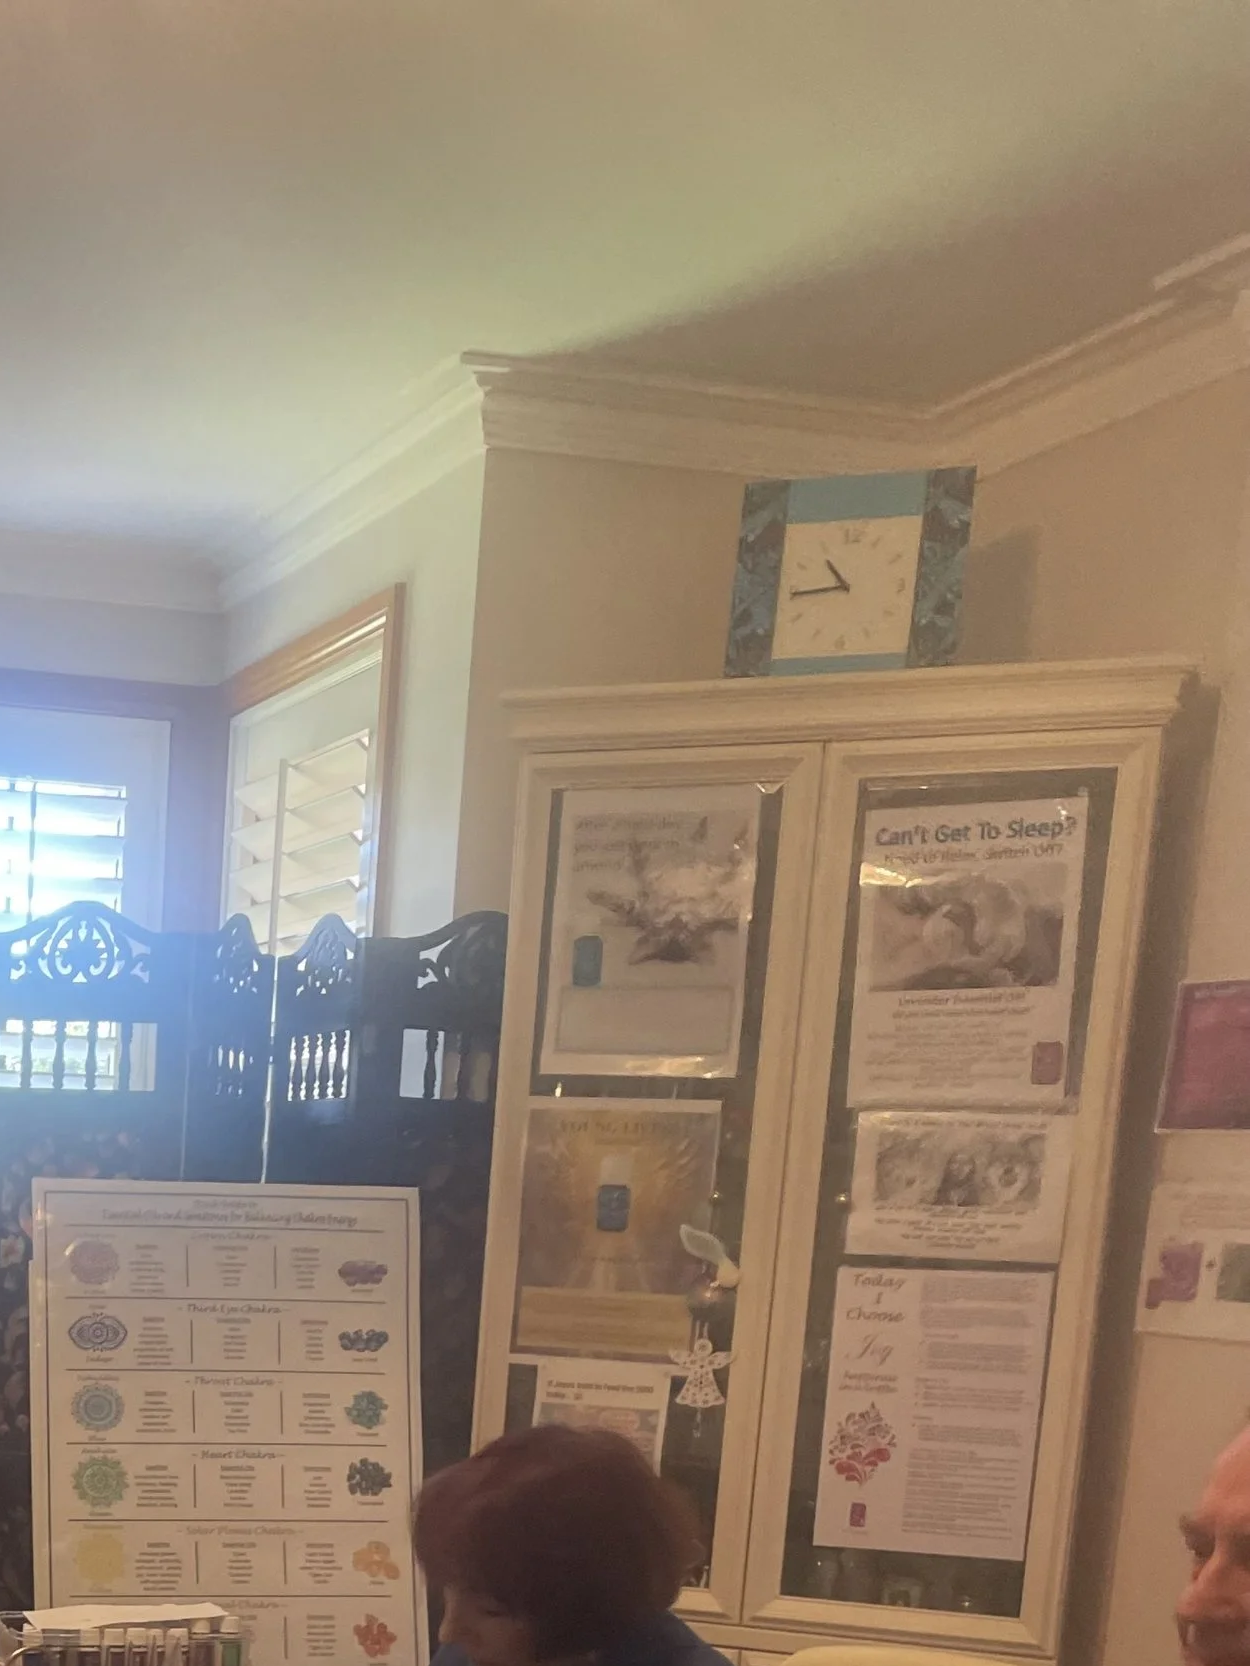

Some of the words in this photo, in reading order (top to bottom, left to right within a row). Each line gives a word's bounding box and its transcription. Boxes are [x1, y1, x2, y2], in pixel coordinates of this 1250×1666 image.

[875, 823, 928, 847] Can't
[934, 823, 972, 844] Get
[978, 821, 1001, 841] To
[1006, 815, 1078, 839] Sleep?
[853, 1272, 907, 1292] Today
